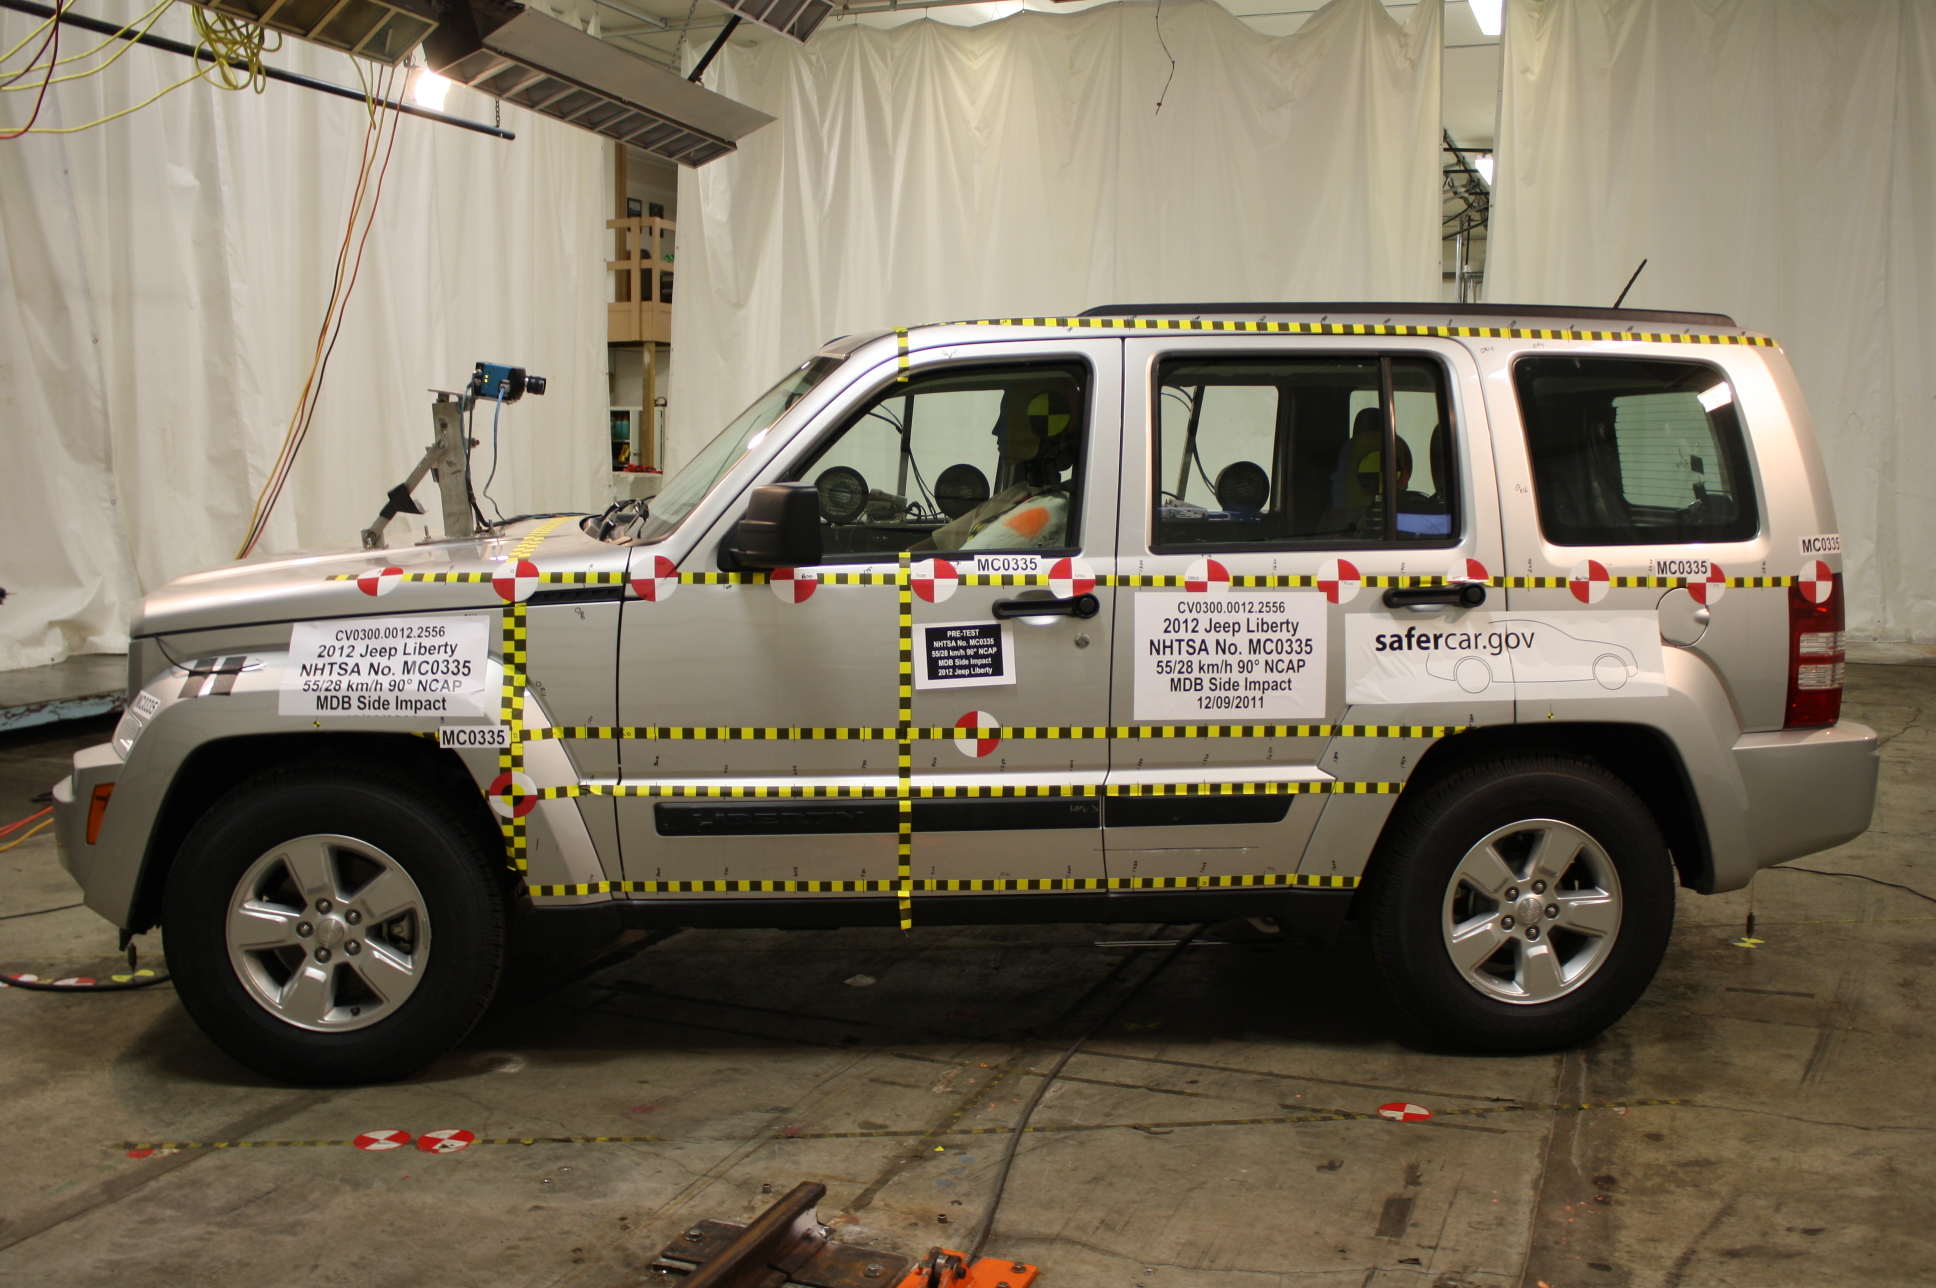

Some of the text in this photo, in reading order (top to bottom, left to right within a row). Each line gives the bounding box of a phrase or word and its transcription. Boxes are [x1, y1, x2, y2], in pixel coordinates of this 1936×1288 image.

[1802, 536, 1840, 553] MC0335
[977, 557, 1038, 572] MC0335
[1657, 560, 1708, 576] MC0335
[1177, 601, 1285, 614] CV0300.0012.2556
[335, 626, 446, 642] CV0300.0012.2556
[947, 629, 980, 638] PRE-TEST
[1163, 617, 1299, 637] 2012 Jeep Liberty
[933, 638, 995, 648] NHTSA No. MC0335
[1149, 638, 1313, 656] NHTSA No. MC0335
[1375, 626, 1535, 656] safercar.gov
[317, 641, 458, 658] 2012 Jeep Liberty
[931, 647, 997, 658] 55/28 km/h 90° NCAP
[300, 659, 472, 677] NHTSA No. MC0335
[938, 657, 992, 667] MDB Side Impact
[1156, 659, 1306, 675] 55/28 km/h 90° NCAP
[938, 667, 993, 676] 2012 Jeep Liberty
[302, 678, 463, 693] 55/28 km/h 90° NCAP
[1170, 677, 1292, 694] MDB Side Impact
[316, 695, 447, 714] MDB Side Impact
[1197, 696, 1264, 709] 12/09/2011
[442, 730, 505, 745] MC0335
